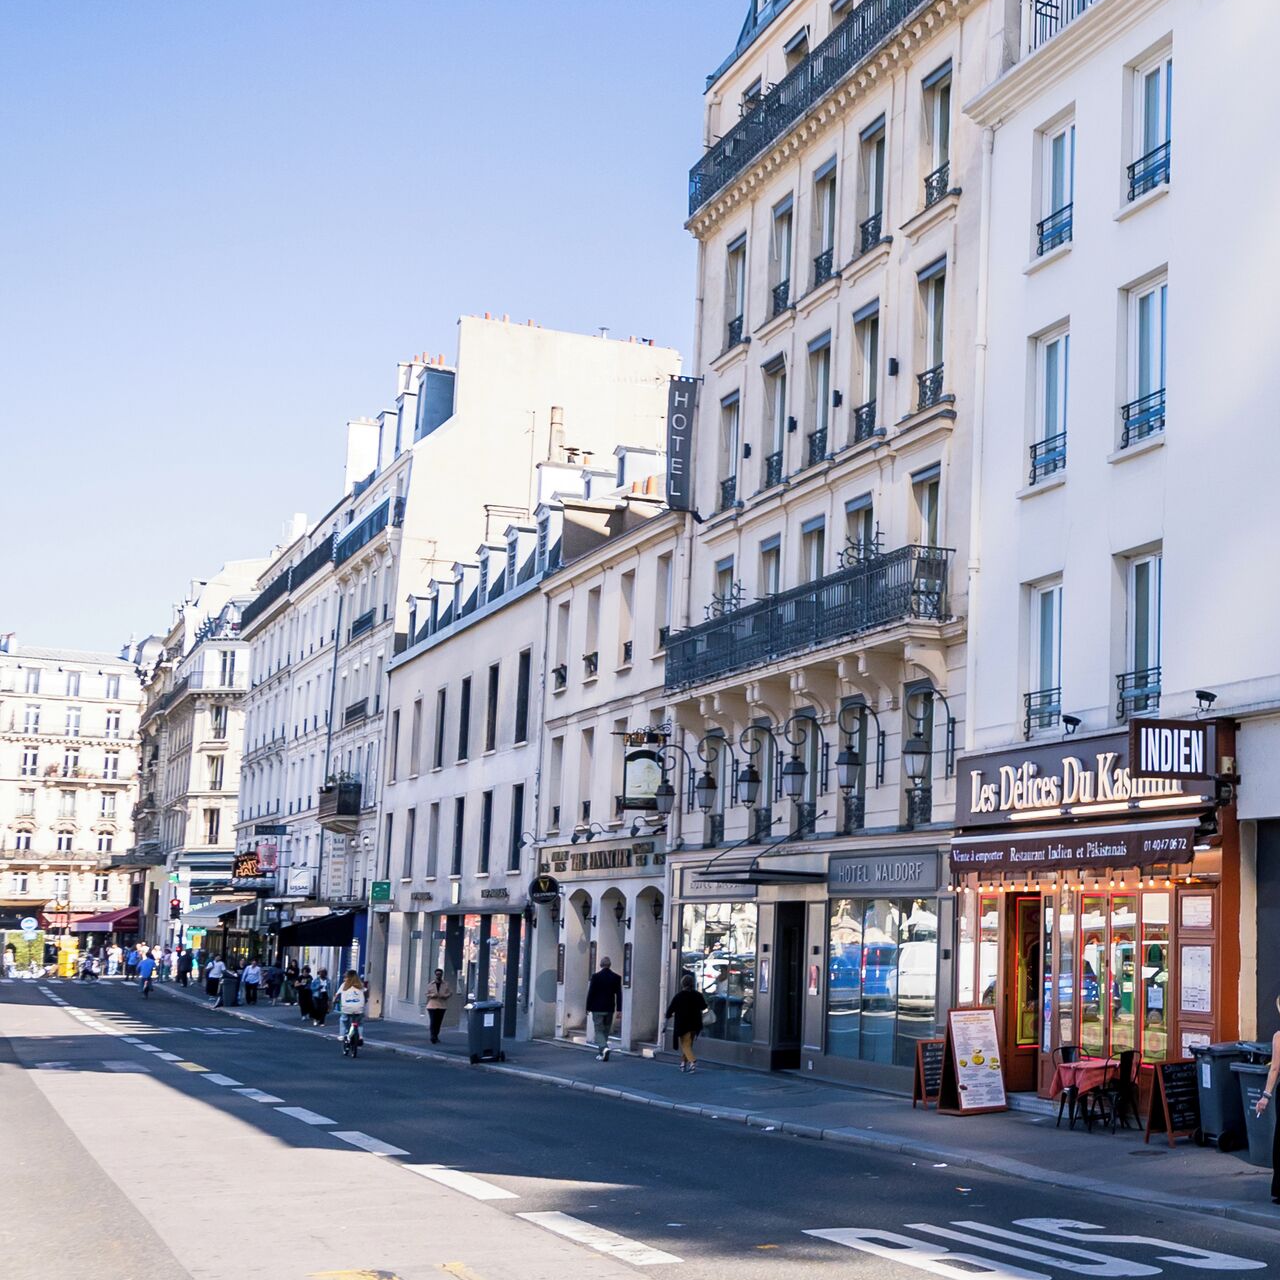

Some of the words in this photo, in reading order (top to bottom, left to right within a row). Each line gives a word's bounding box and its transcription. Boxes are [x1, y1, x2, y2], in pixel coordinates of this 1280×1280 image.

[669, 391, 689, 496] HOTEL
[1140, 727, 1203, 774] INDIEN
[970, 770, 999, 813] Les
[1000, 761, 1062, 811] Délices
[1062, 756, 1096, 804] Du
[839, 865, 869, 883] HOTEL
[875, 862, 922, 881] WALDORF
[953, 849, 969, 862] Vente
[975, 851, 1004, 864] emporter
[1010, 847, 1046, 862] Restaurant
[1048, 844, 1073, 860] Indien
[1076, 847, 1084, 859] et
